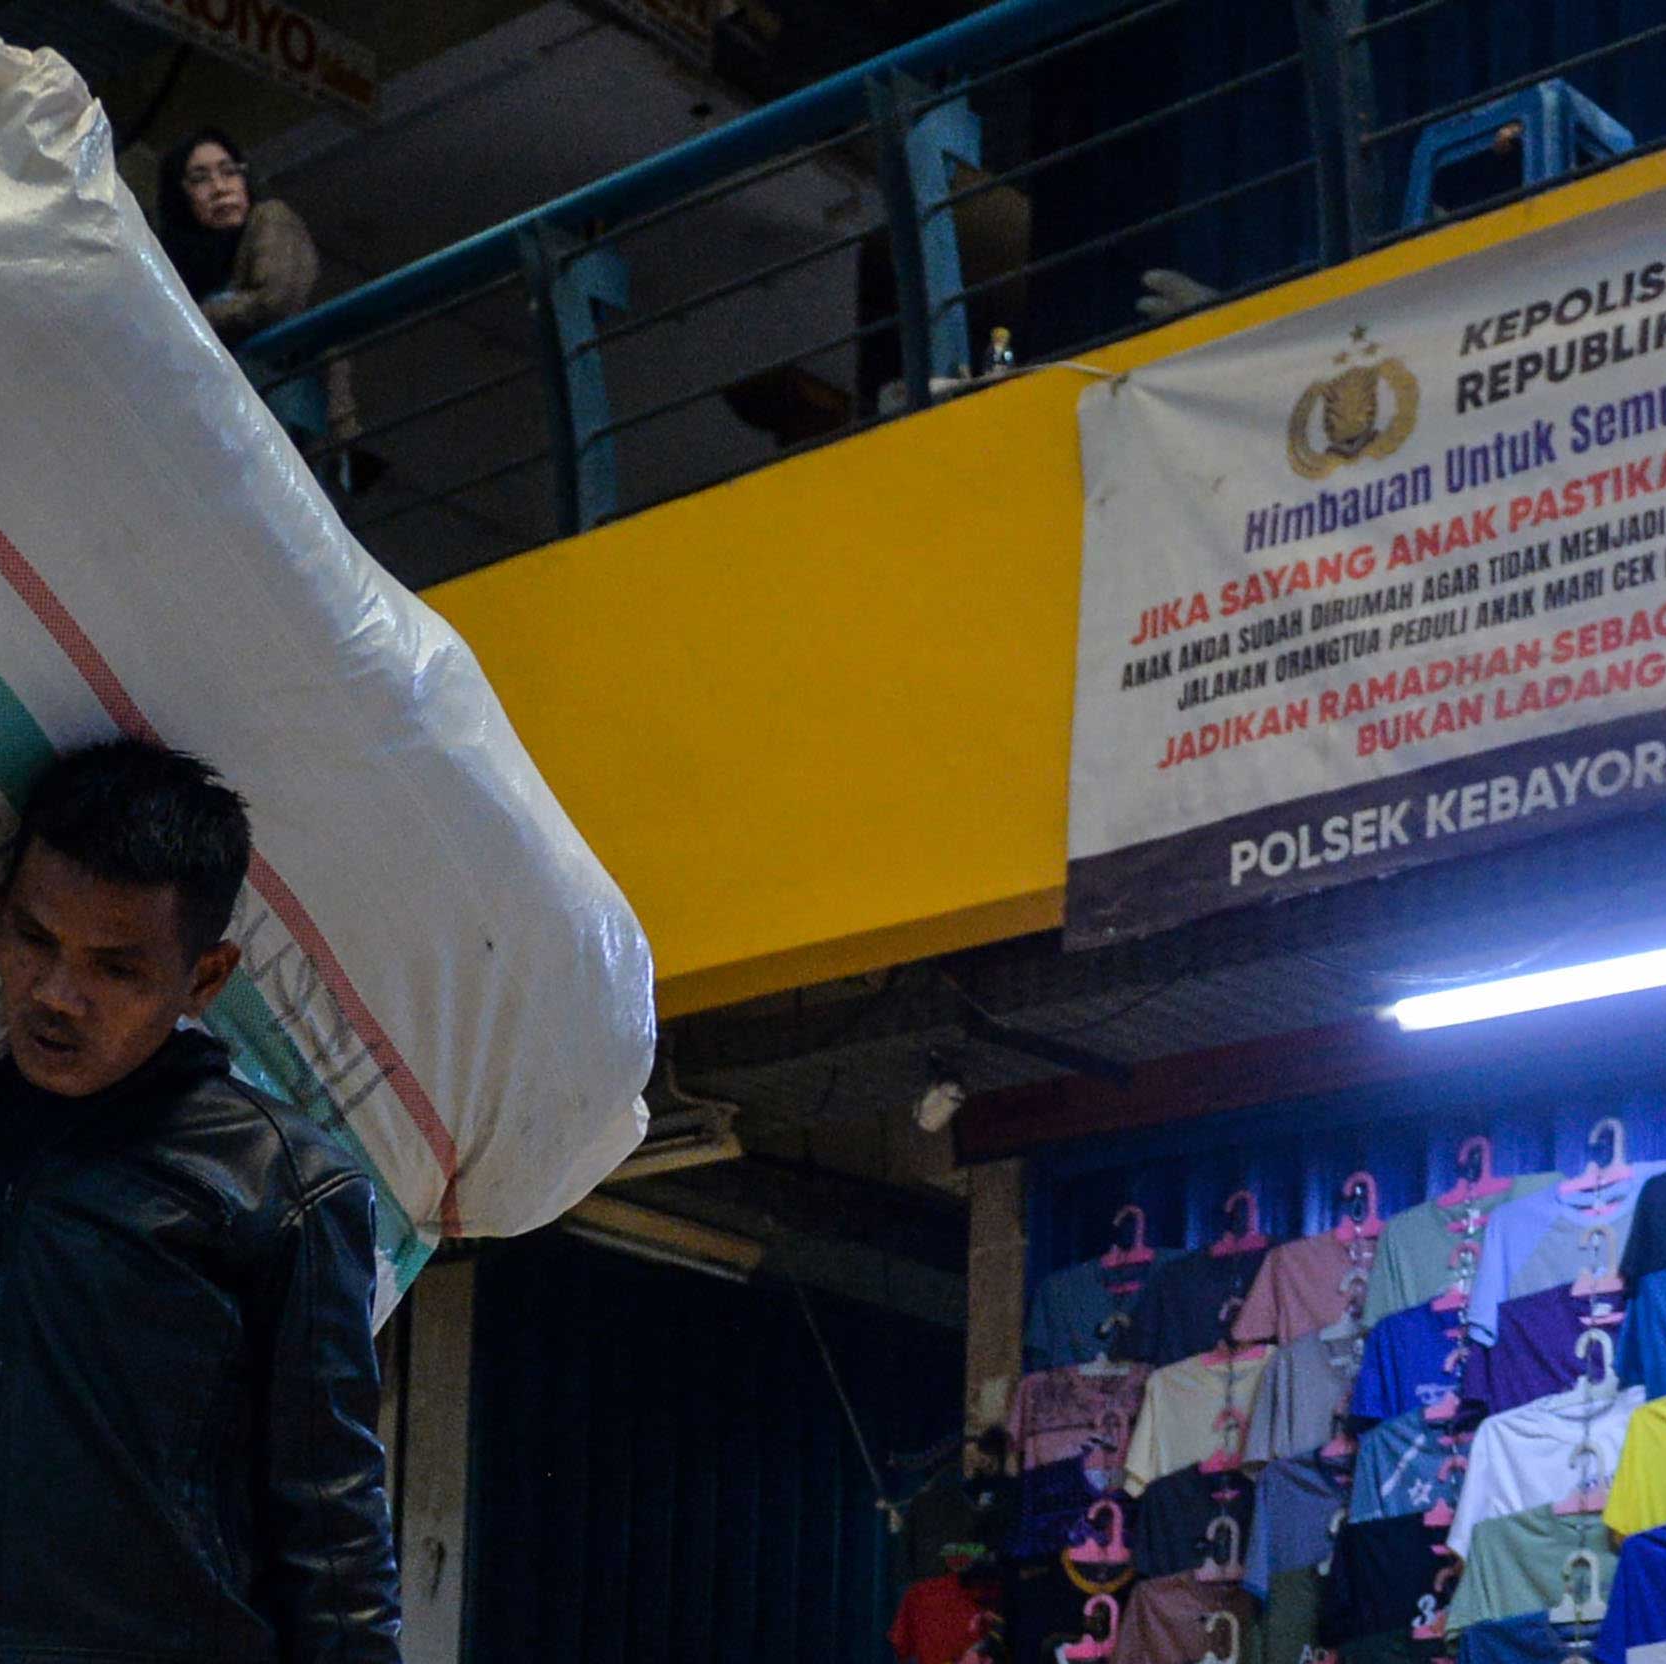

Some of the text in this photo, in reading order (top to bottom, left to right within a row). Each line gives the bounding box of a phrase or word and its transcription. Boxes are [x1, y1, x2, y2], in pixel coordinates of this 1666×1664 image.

[1243, 463, 1432, 553] Himbauan
[1444, 418, 1555, 495] Untuk
[1120, 649, 1173, 692] ANAK
[1177, 631, 1231, 674] ANDA
[1237, 607, 1304, 653] SUDAH
[1310, 582, 1414, 634] DIRUMAH
[1420, 564, 1480, 606] AGAR
[1488, 539, 1552, 586] TIDAK
[1558, 506, 1666, 568] MENJADI
[1129, 592, 1210, 646] JIKA
[1218, 545, 1375, 616] SAYANG
[1386, 505, 1498, 570] ANAK
[1176, 662, 1267, 713] JALANAN
[1275, 627, 1381, 685] ORANGTUA
[1388, 604, 1469, 650] PEDULI
[1474, 577, 1535, 620] ANAK
[1542, 564, 1603, 611] MARI
[1612, 553, 1656, 592] CEK
[1156, 696, 1309, 771] JADIKAN
[1318, 637, 1543, 726] RAMADHAN
[1355, 692, 1484, 759] BUKAN
[1230, 800, 1410, 887] POLSEK
